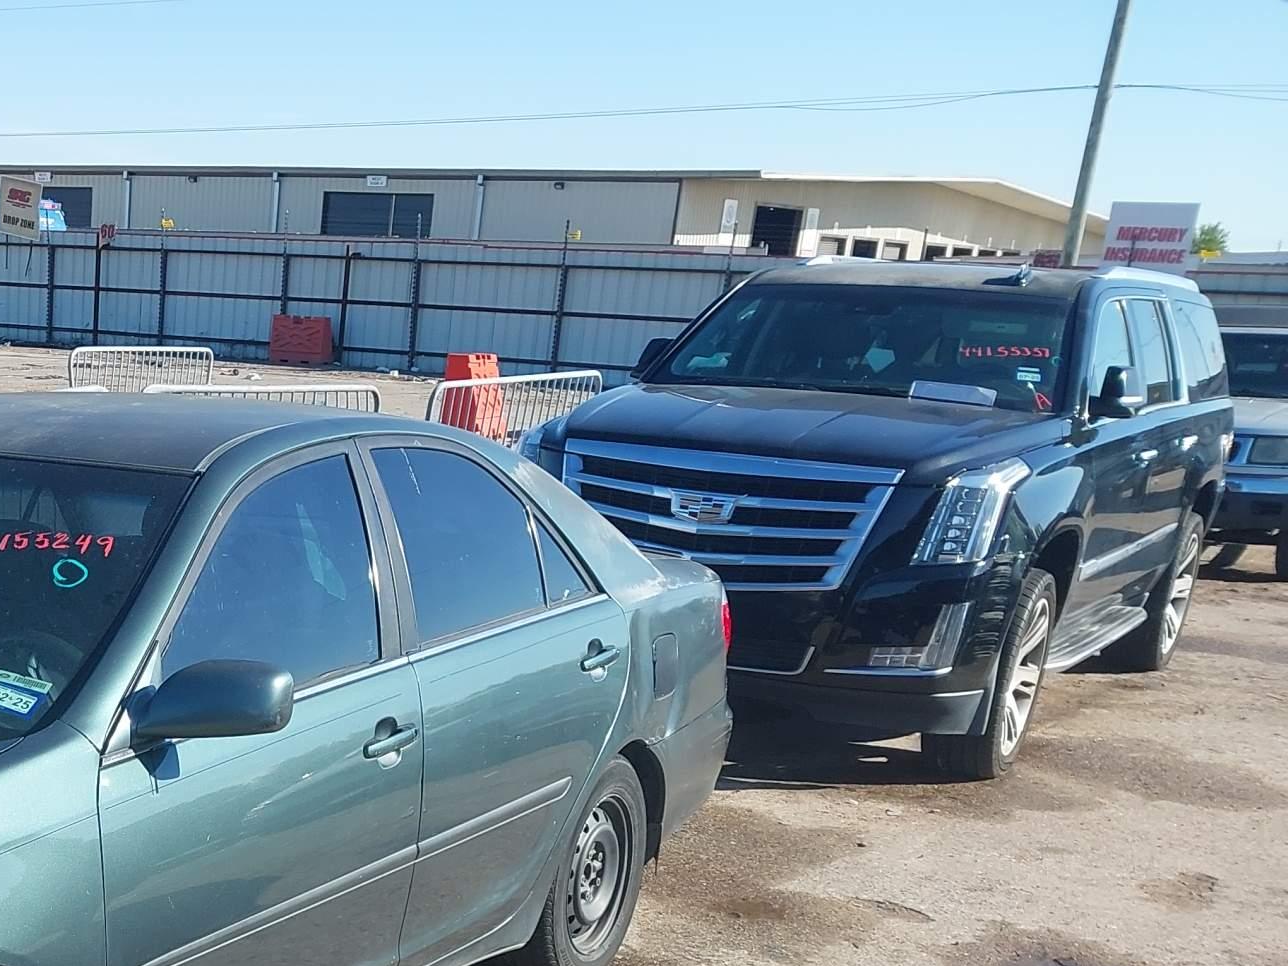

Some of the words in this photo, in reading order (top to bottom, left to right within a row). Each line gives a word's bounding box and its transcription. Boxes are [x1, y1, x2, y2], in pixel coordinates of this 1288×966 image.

[3, 214, 20, 226] DROP
[20, 219, 35, 230] ZONE
[1116, 226, 1188, 242] MERCURY
[1103, 246, 1187, 264] INSURANCE
[1035, 392, 1052, 410] A
[12, 697, 32, 709] 25
